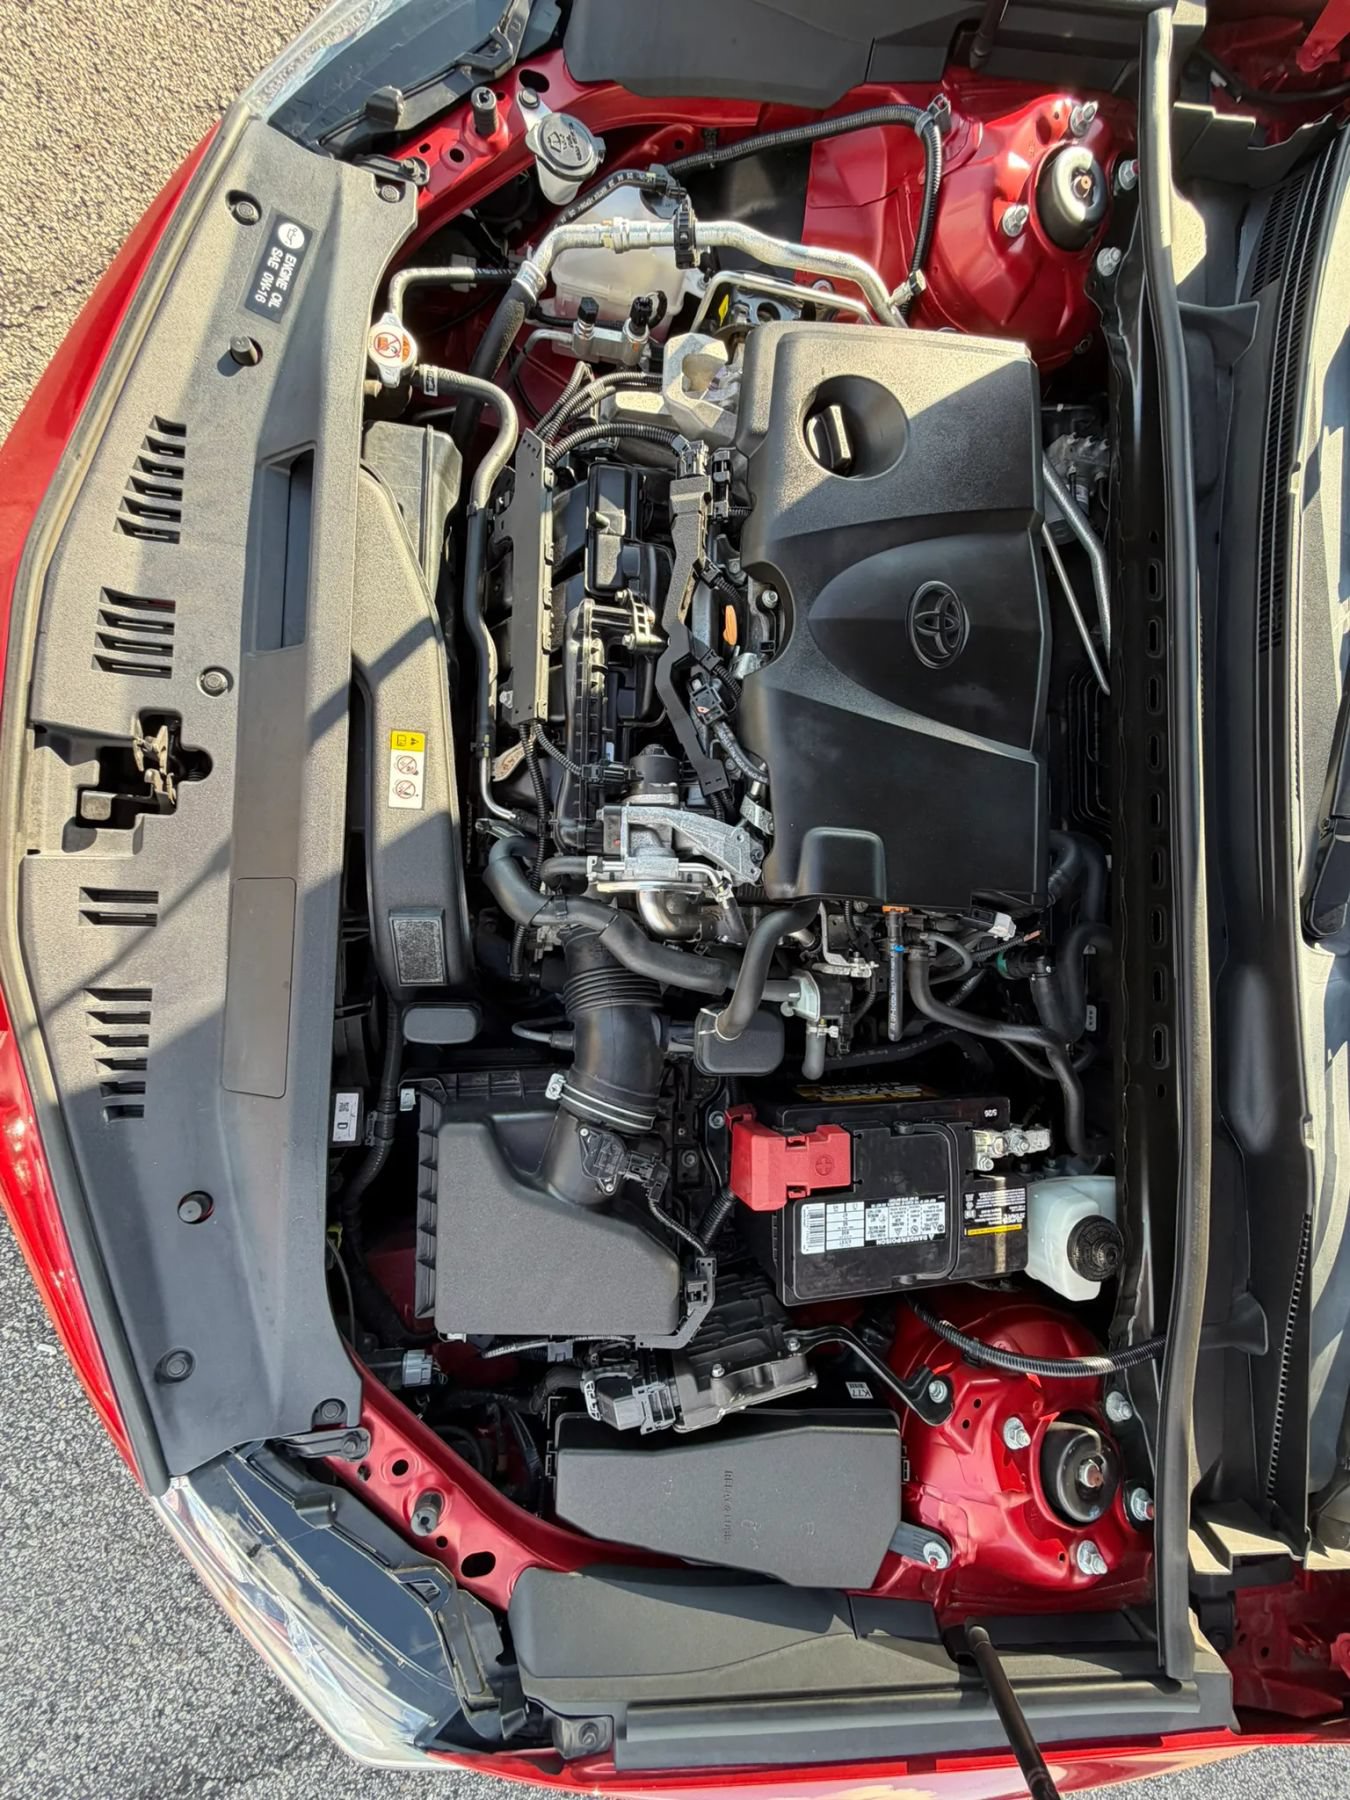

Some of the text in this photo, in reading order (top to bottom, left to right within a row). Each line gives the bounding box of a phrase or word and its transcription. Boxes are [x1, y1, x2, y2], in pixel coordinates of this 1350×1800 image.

[254, 247, 283, 303] SAE 0W-16
[268, 253, 297, 308] ENGINE OIL
